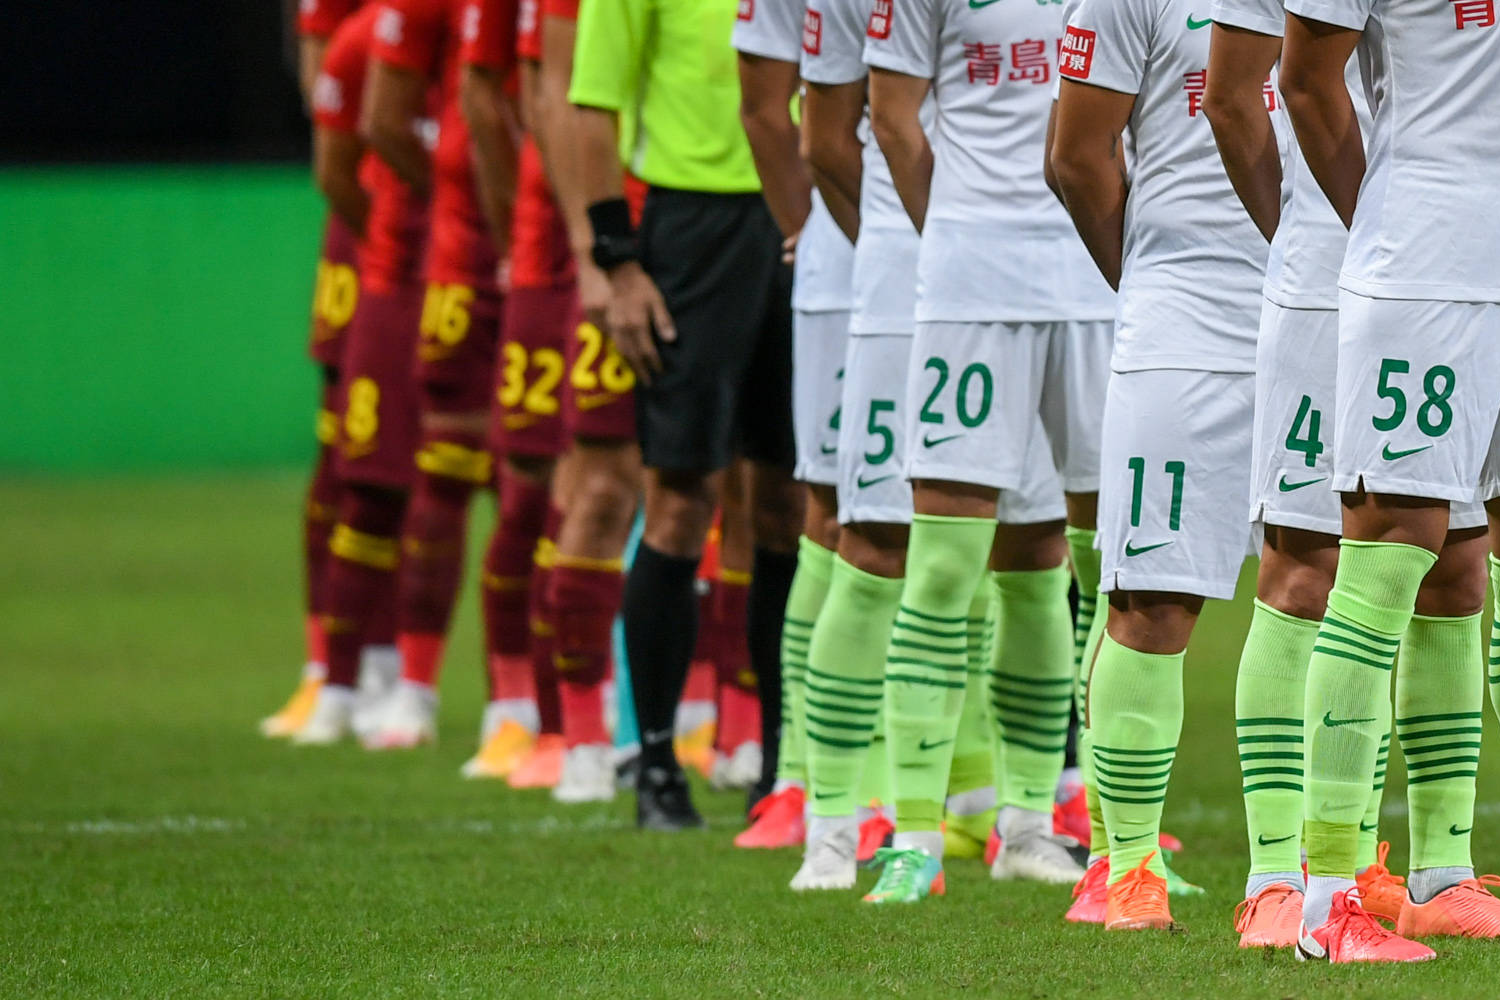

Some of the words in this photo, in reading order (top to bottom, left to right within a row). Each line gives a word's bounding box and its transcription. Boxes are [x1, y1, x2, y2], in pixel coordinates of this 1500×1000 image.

[963, 38, 1063, 86] 青島
[499, 341, 564, 415] 32
[919, 356, 994, 428] 20
[1372, 358, 1456, 437] 58
[864, 400, 896, 465] 5
[1284, 394, 1324, 467] 4
[1128, 456, 1186, 531] 11
